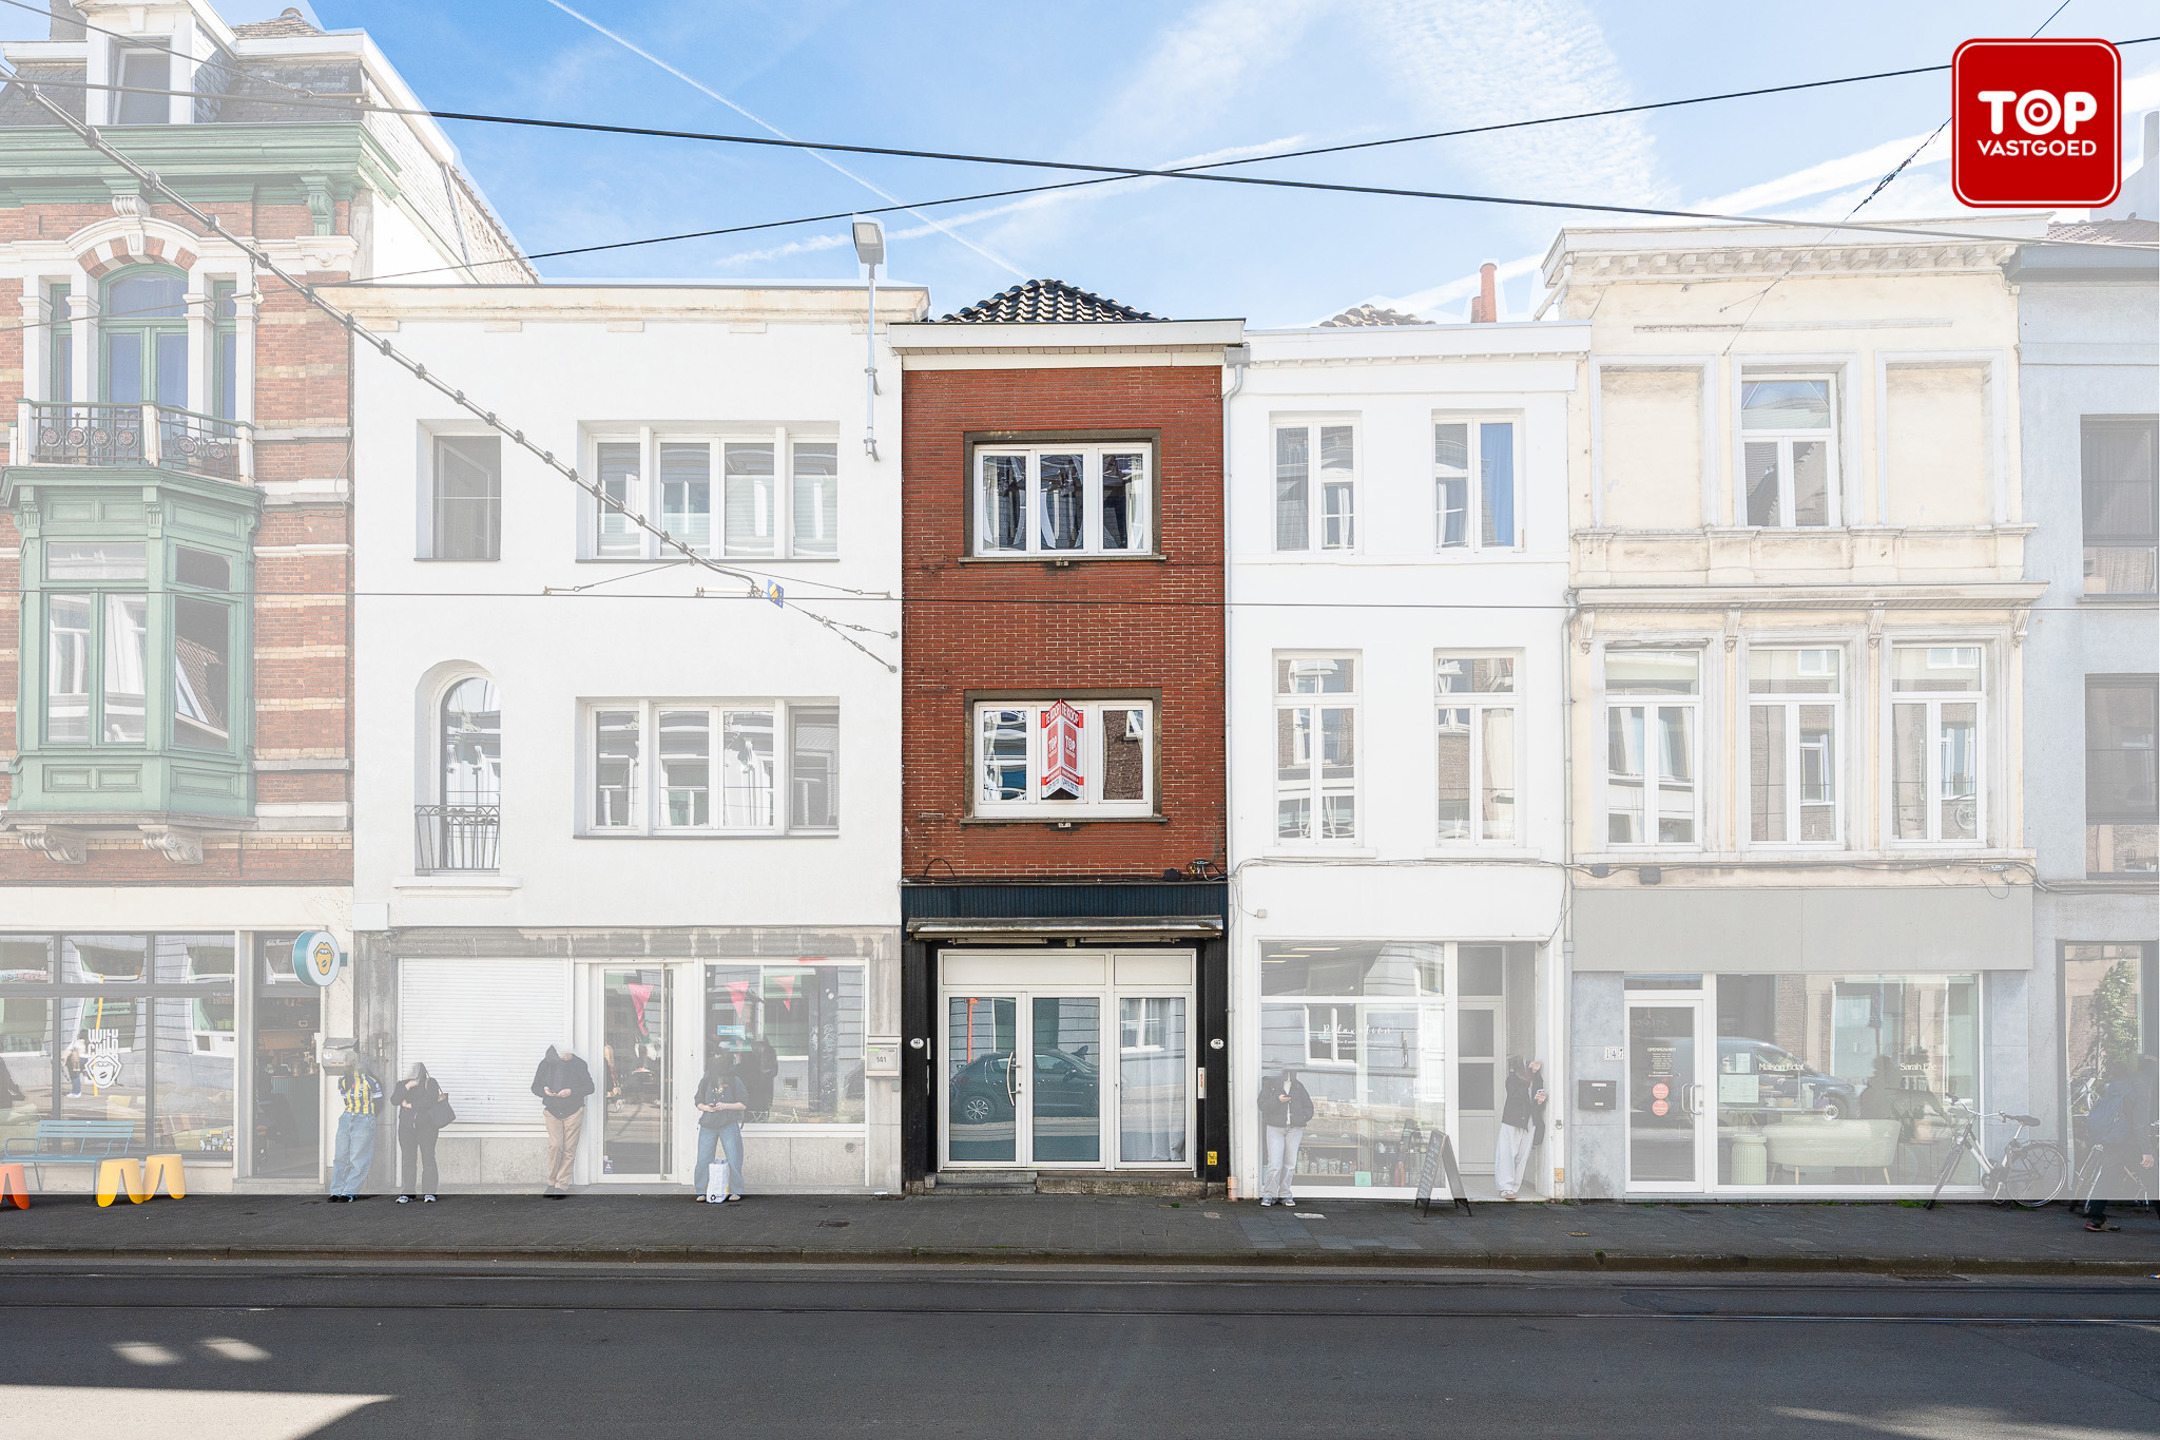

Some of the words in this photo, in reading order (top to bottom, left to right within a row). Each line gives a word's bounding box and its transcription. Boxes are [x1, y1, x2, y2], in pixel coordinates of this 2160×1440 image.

[1064, 735, 1076, 753] TOP
[88, 1029, 119, 1043] WILD
[1899, 1062, 1922, 1071] Sarah
